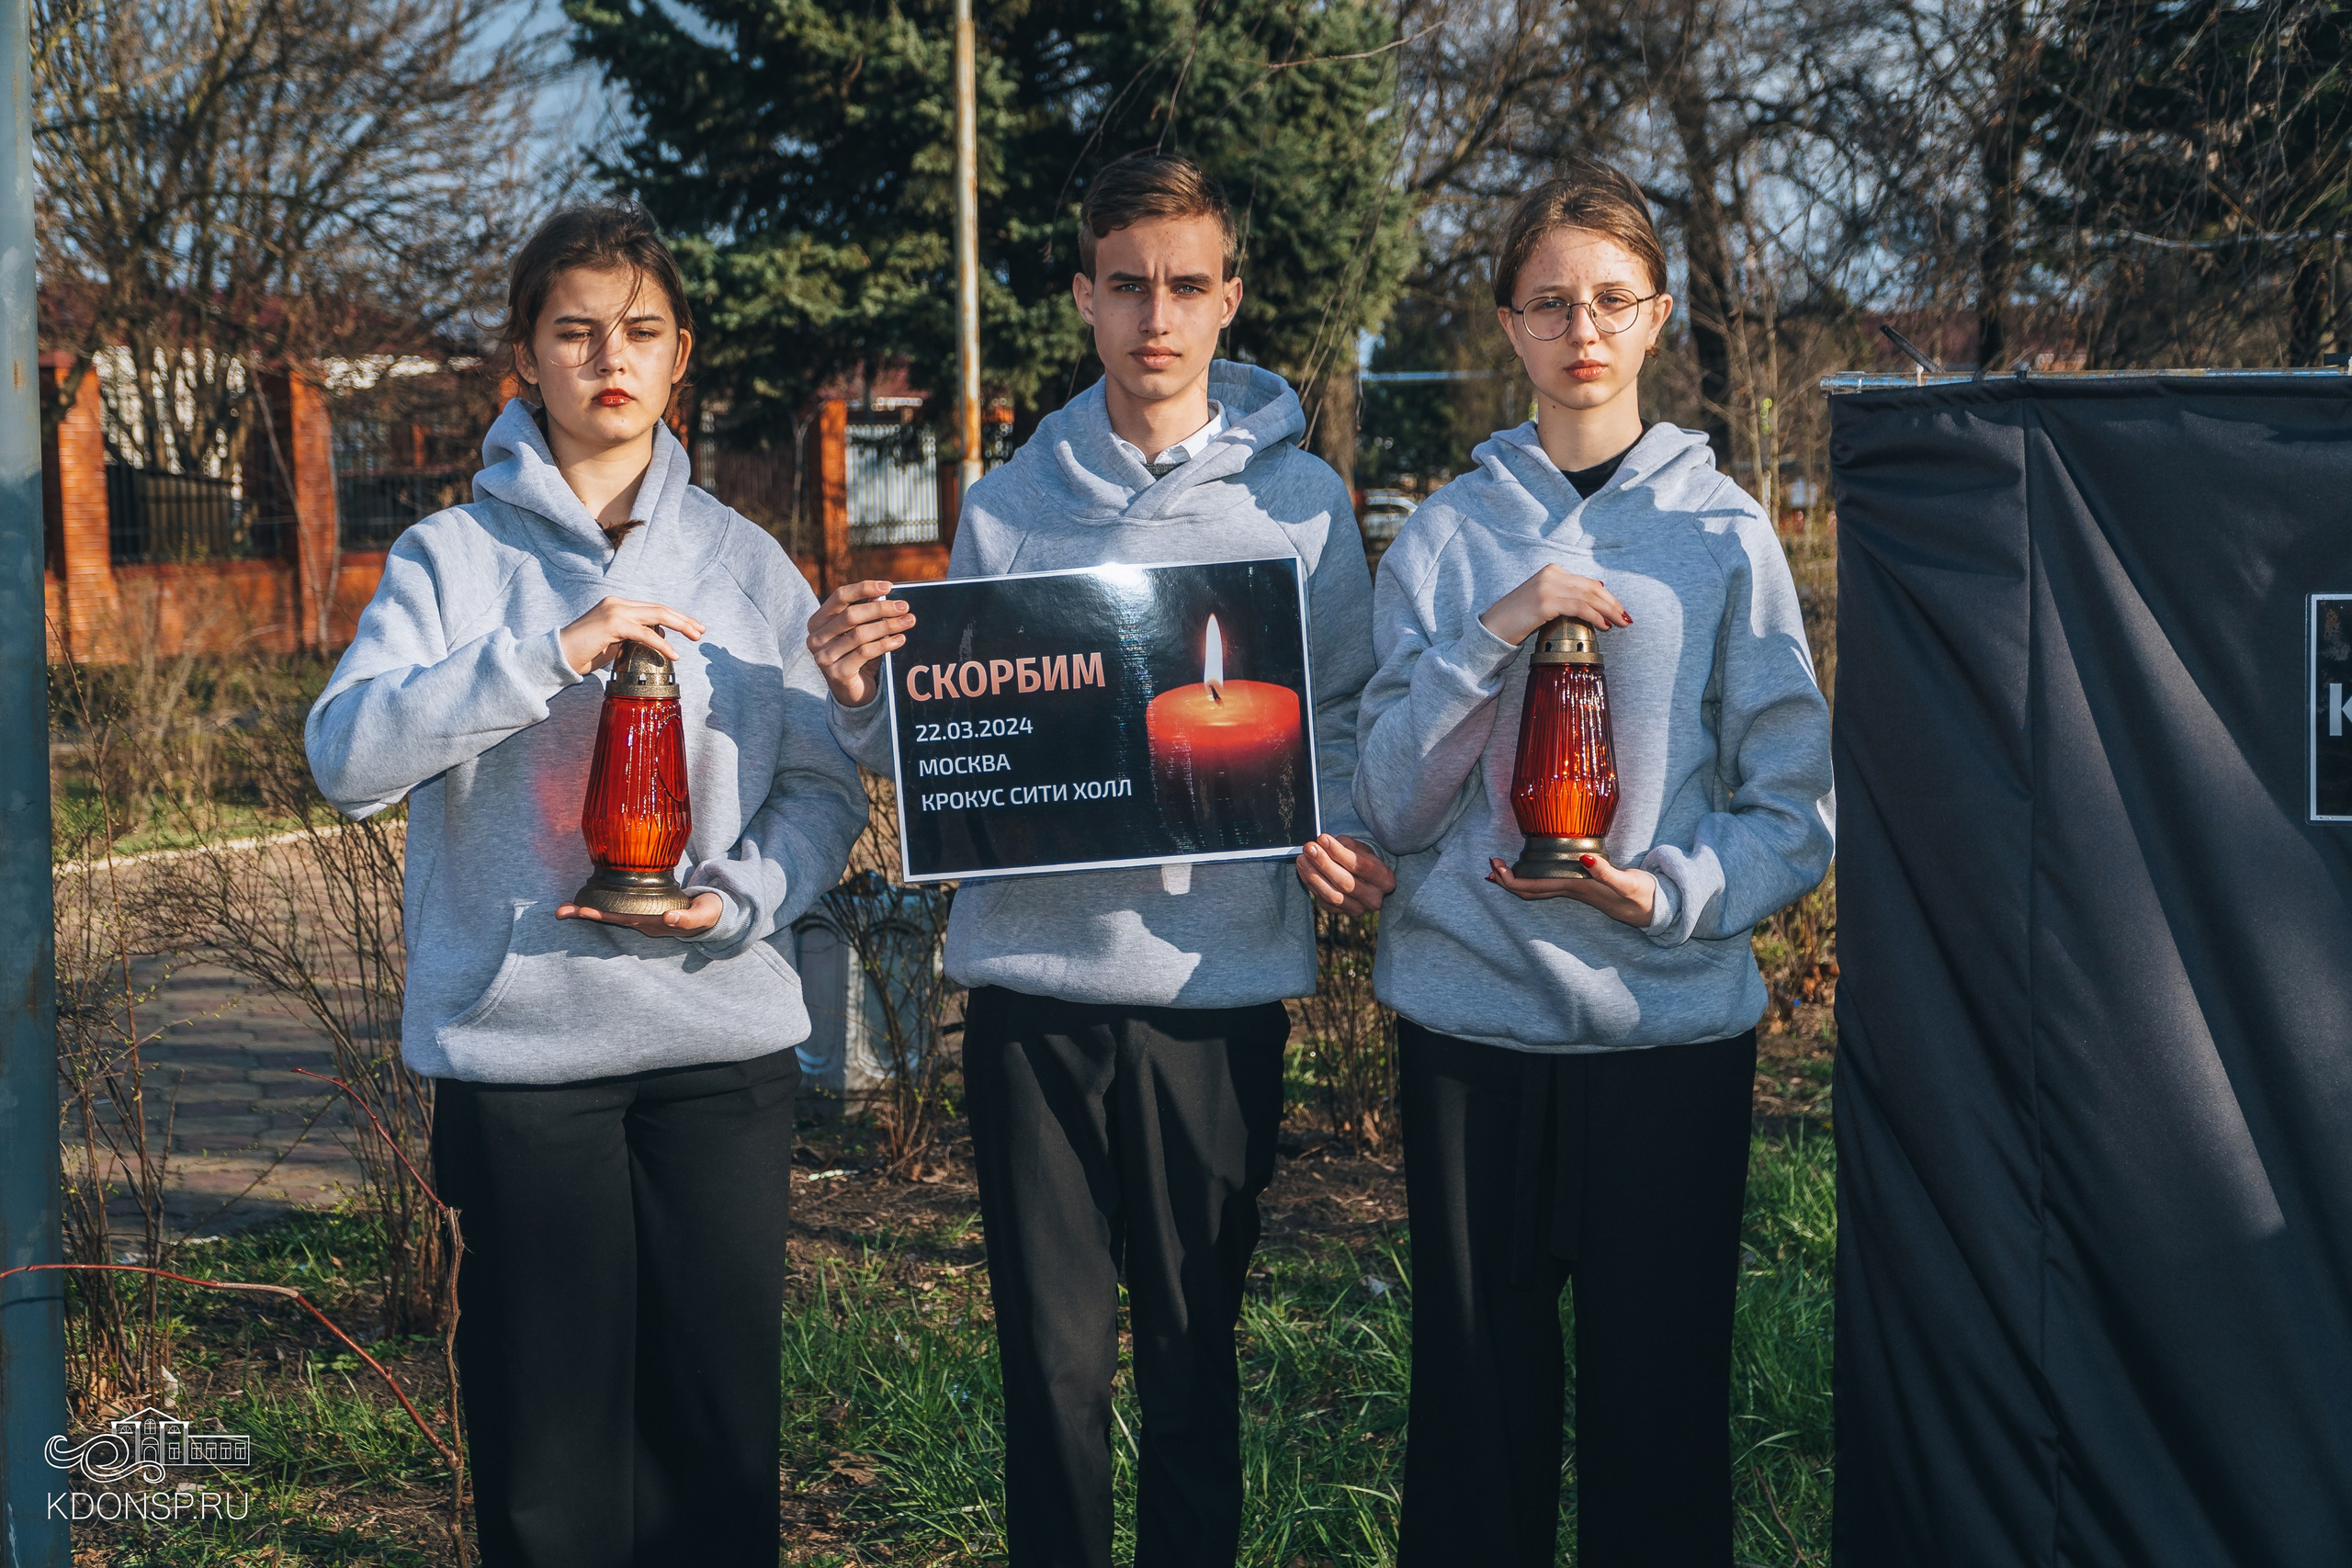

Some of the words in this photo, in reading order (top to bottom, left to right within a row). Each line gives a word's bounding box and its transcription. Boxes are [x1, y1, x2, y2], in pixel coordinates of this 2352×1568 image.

[906, 652, 1105, 701] СКОРБИМ
[916, 716, 1034, 742] 22.03.2024
[919, 753, 1012, 777] МОСКВА
[922, 788, 1005, 811] КРОКУС
[1010, 784, 1069, 805] СИТИ
[1073, 779, 1133, 801] ХОЛЛ
